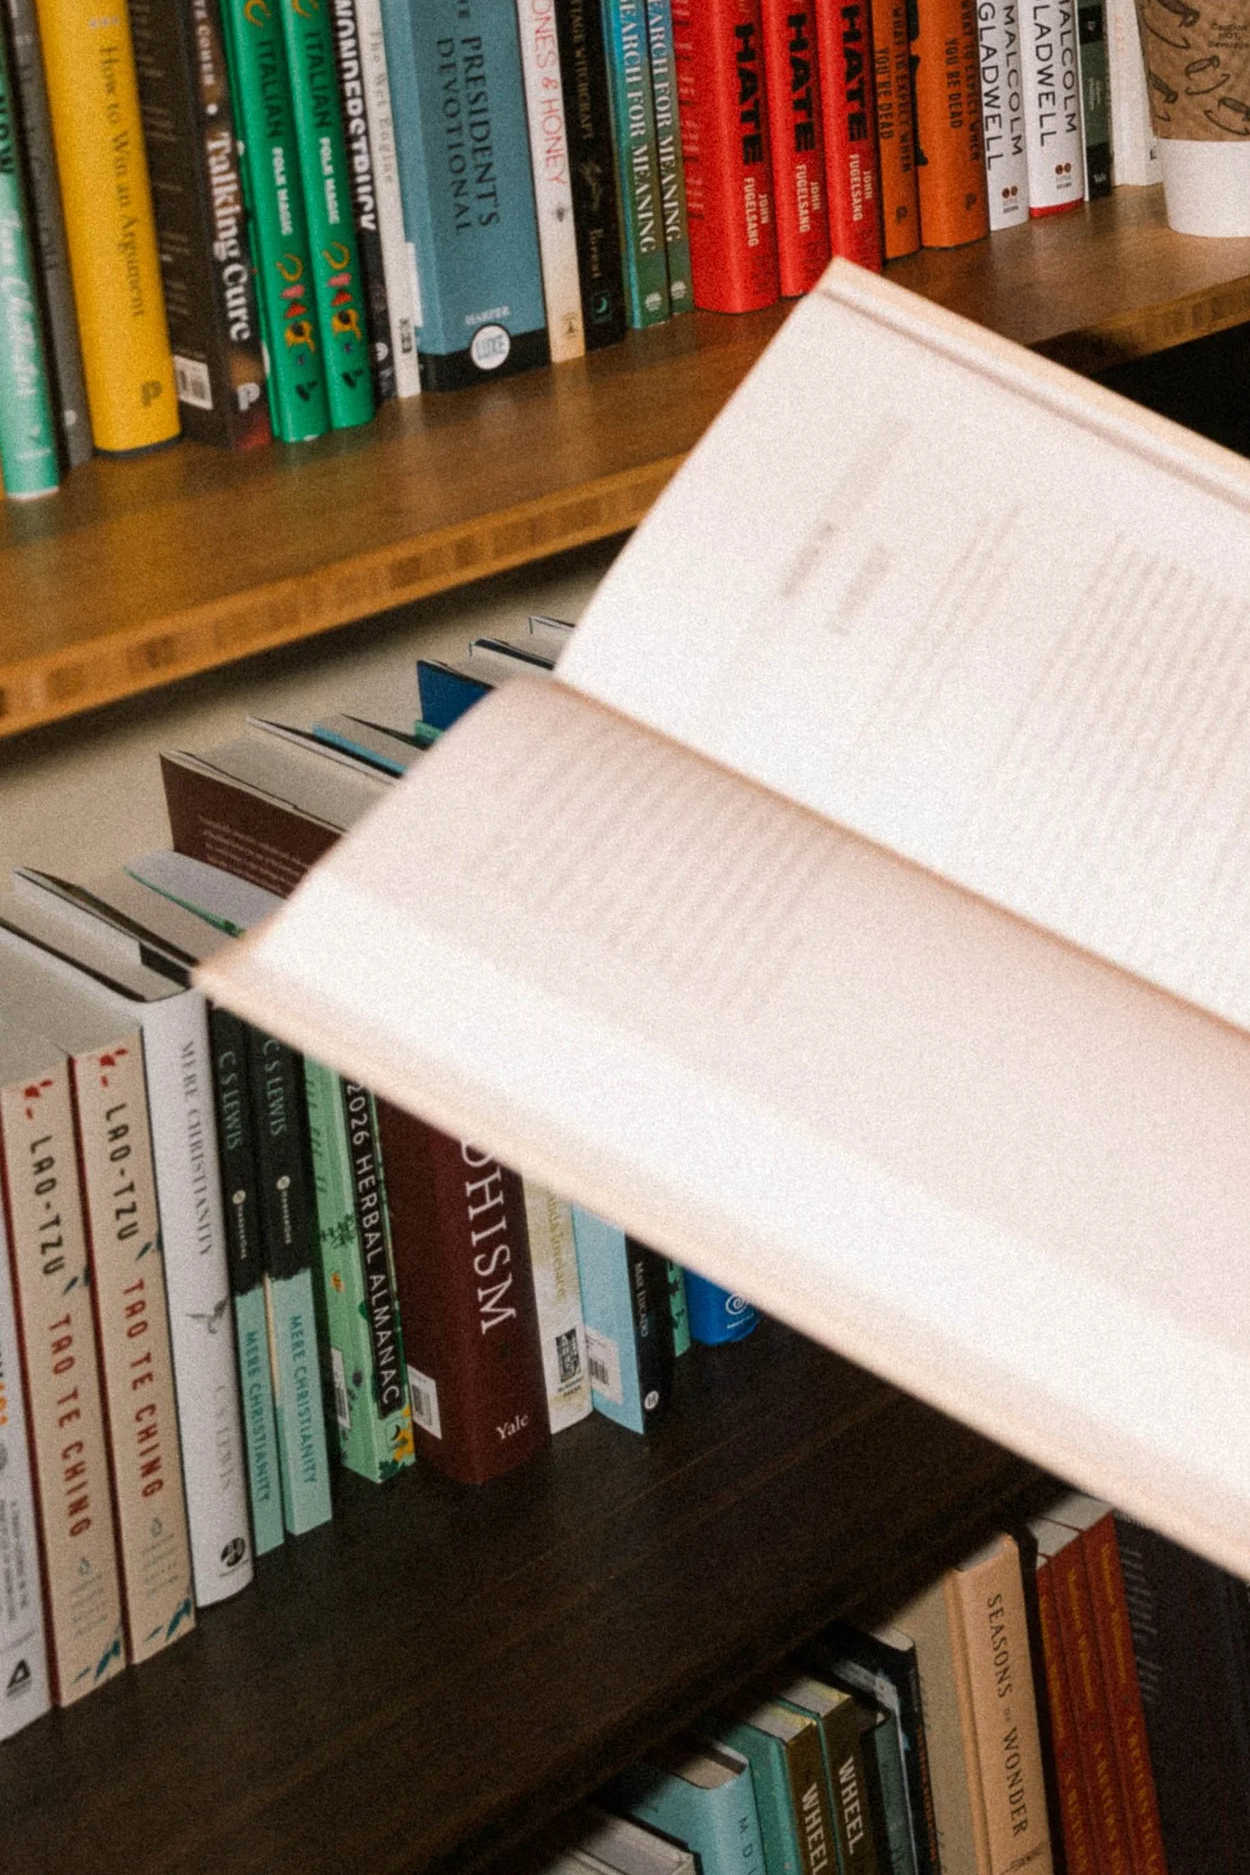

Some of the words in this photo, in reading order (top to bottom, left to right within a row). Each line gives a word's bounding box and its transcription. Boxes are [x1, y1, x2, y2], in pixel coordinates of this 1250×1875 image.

[98, 44, 123, 95] How
[255, 37, 287, 139] ITALIAN
[303, 27, 333, 130] ITALIAN
[536, 73, 559, 90] &
[731, 23, 766, 164] HATE
[784, 12, 819, 152] HATE
[839, 3, 868, 140] HATE
[977, 1, 1005, 169] GLADWELL
[1003, 5, 1023, 156] MALCOLM
[105, 101, 126, 124] to
[435, 36, 471, 234] DEVOTIONAL
[458, 34, 501, 227] PRESIDENT'S
[625, 89, 648, 137] FOR
[651, 79, 676, 128] FOR
[877, 101, 895, 139] DEAD
[948, 92, 963, 129] DEAD
[108, 129, 133, 176] Win
[269, 145, 287, 186] FOLK
[318, 135, 334, 175] FOLK
[539, 96, 569, 185] HONEY
[116, 183, 133, 207] an
[197, 130, 247, 261] Talking
[275, 187, 294, 235] MAGIC
[323, 177, 340, 225] MAGIC
[629, 142, 659, 252] MEANING
[656, 134, 686, 243] MEANING
[741, 176, 760, 246] FUGELSANG
[757, 192, 770, 223] JOHN
[793, 163, 812, 232] FUGELSANG
[847, 153, 864, 221] FUGELSANG
[116, 212, 151, 317] Argument
[220, 262, 256, 341] Cure
[475, 336, 506, 360] LUXE
[180, 1040, 200, 1097] MERE
[217, 1050, 236, 1068] C
[219, 1071, 238, 1085] S
[261, 1038, 280, 1055] C
[263, 1059, 281, 1072] S
[220, 1089, 243, 1149] LEWIS
[265, 1076, 287, 1136] LEWIS
[346, 1083, 374, 1145] 2026
[105, 1102, 139, 1240] LAO-TZU
[185, 1106, 212, 1254] CHRISTIANITY
[29, 1135, 65, 1275] LAO-TZU
[354, 1153, 386, 1263] HERBAL
[123, 1278, 148, 1338] TAO
[288, 1315, 306, 1360] MERE
[366, 1272, 401, 1405] ALMANAC
[48, 1313, 76, 1374] TAO
[129, 1351, 152, 1391] TE
[244, 1331, 262, 1374] MERE
[55, 1388, 81, 1427] TE
[292, 1365, 317, 1483] CHRISTIANITY
[496, 1413, 528, 1442] Yale
[134, 1403, 163, 1497] CHING
[247, 1381, 270, 1501] CHRISTIANITY
[60, 1441, 91, 1536] CHING
[985, 1592, 1013, 1698] SEASONS
[999, 1727, 1027, 1839] WONDER
[796, 1782, 832, 1875] WHEEL
[832, 1756, 870, 1854] WHEEL
